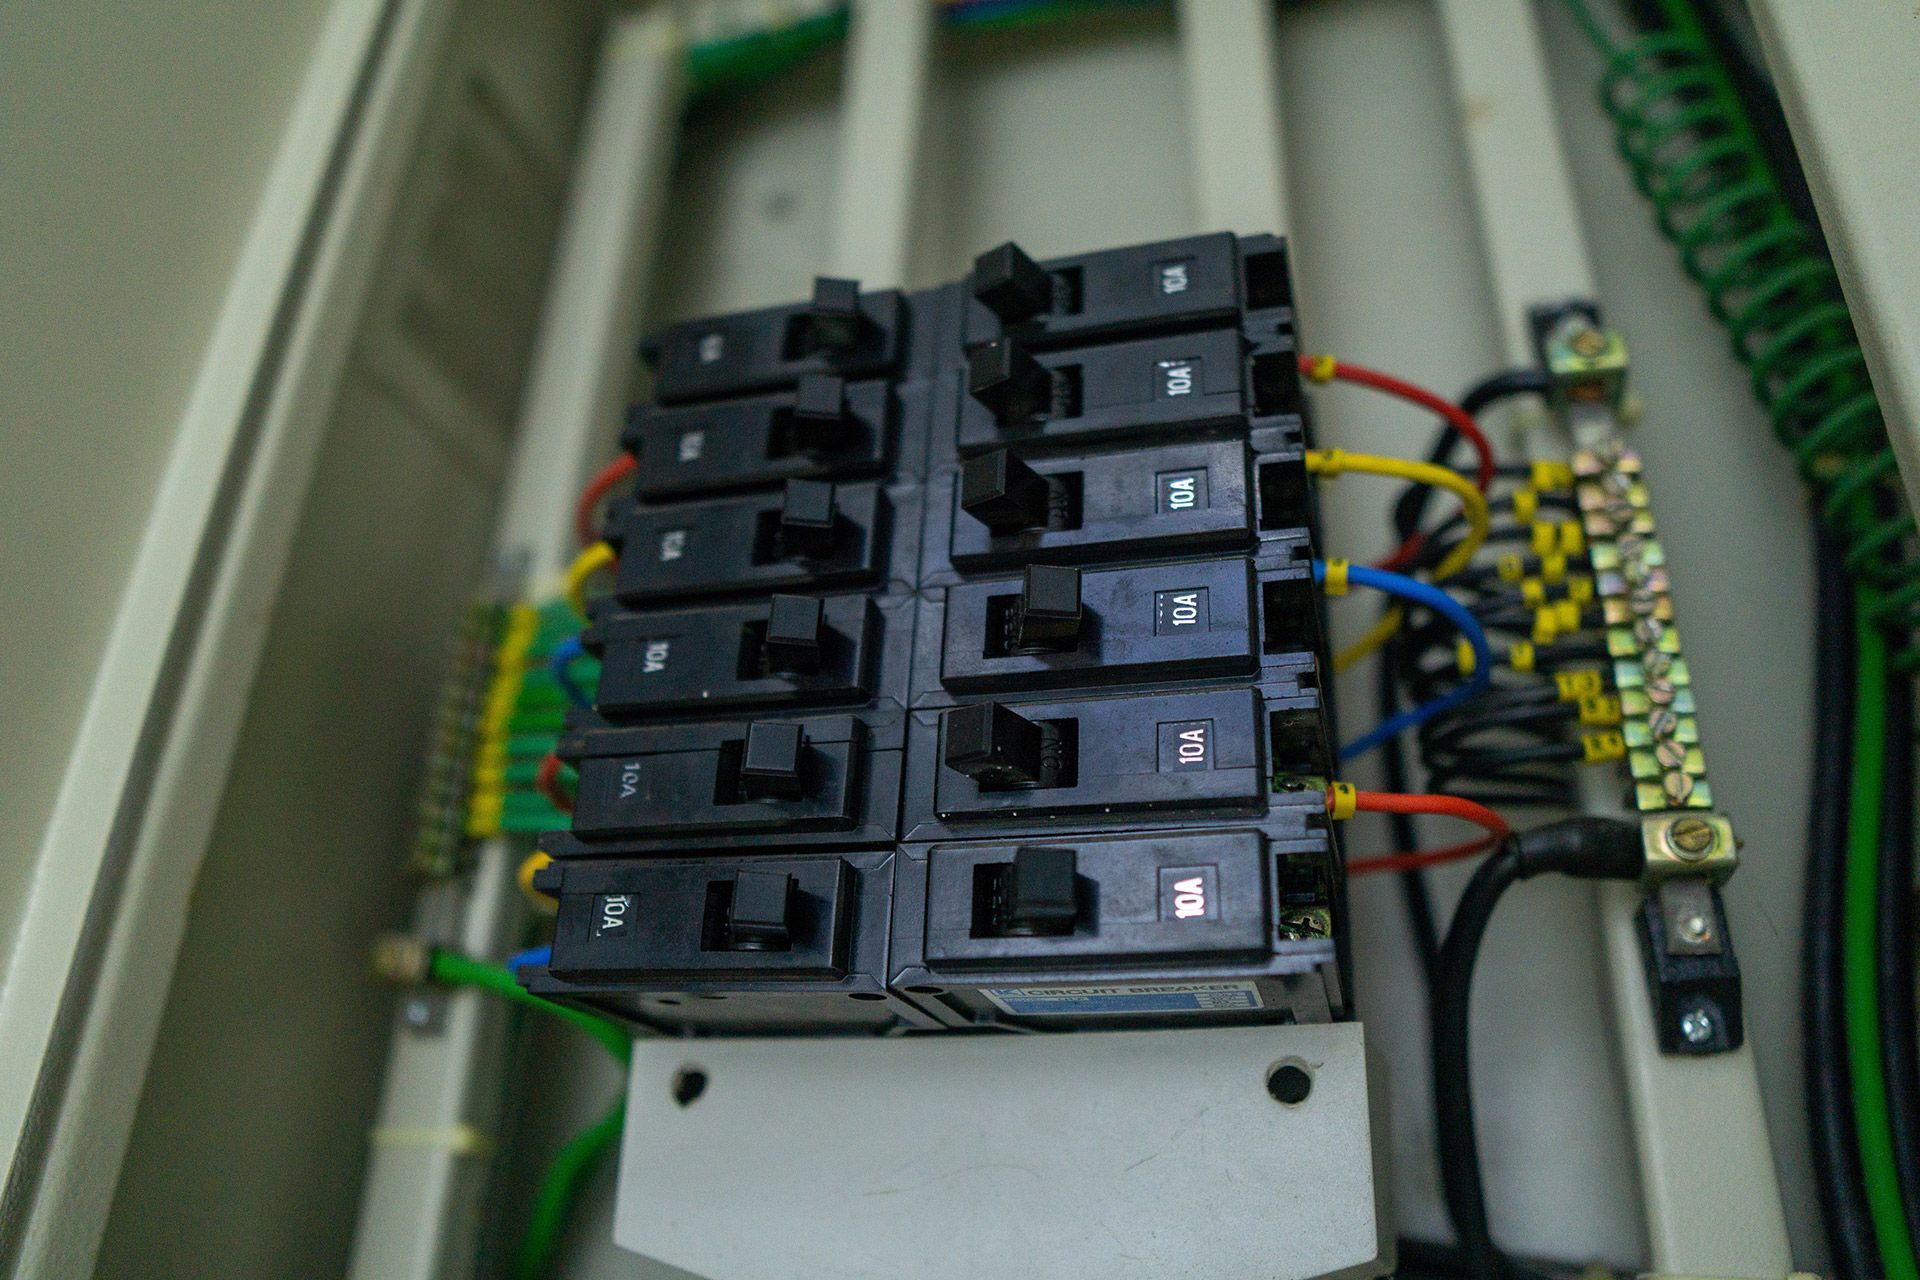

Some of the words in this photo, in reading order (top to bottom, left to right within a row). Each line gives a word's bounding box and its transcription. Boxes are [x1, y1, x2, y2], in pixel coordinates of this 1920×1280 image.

[1167, 366, 1192, 397] 10A
[1169, 477, 1195, 510] 10A
[1172, 593, 1198, 626] 10A
[643, 642, 669, 674] 10A
[1178, 728, 1204, 764] 10A
[602, 895, 628, 930] 10A
[1174, 877, 1206, 919] 10A
[1027, 986, 1118, 996] CIRCUIT
[1128, 984, 1240, 994] BREAKER
